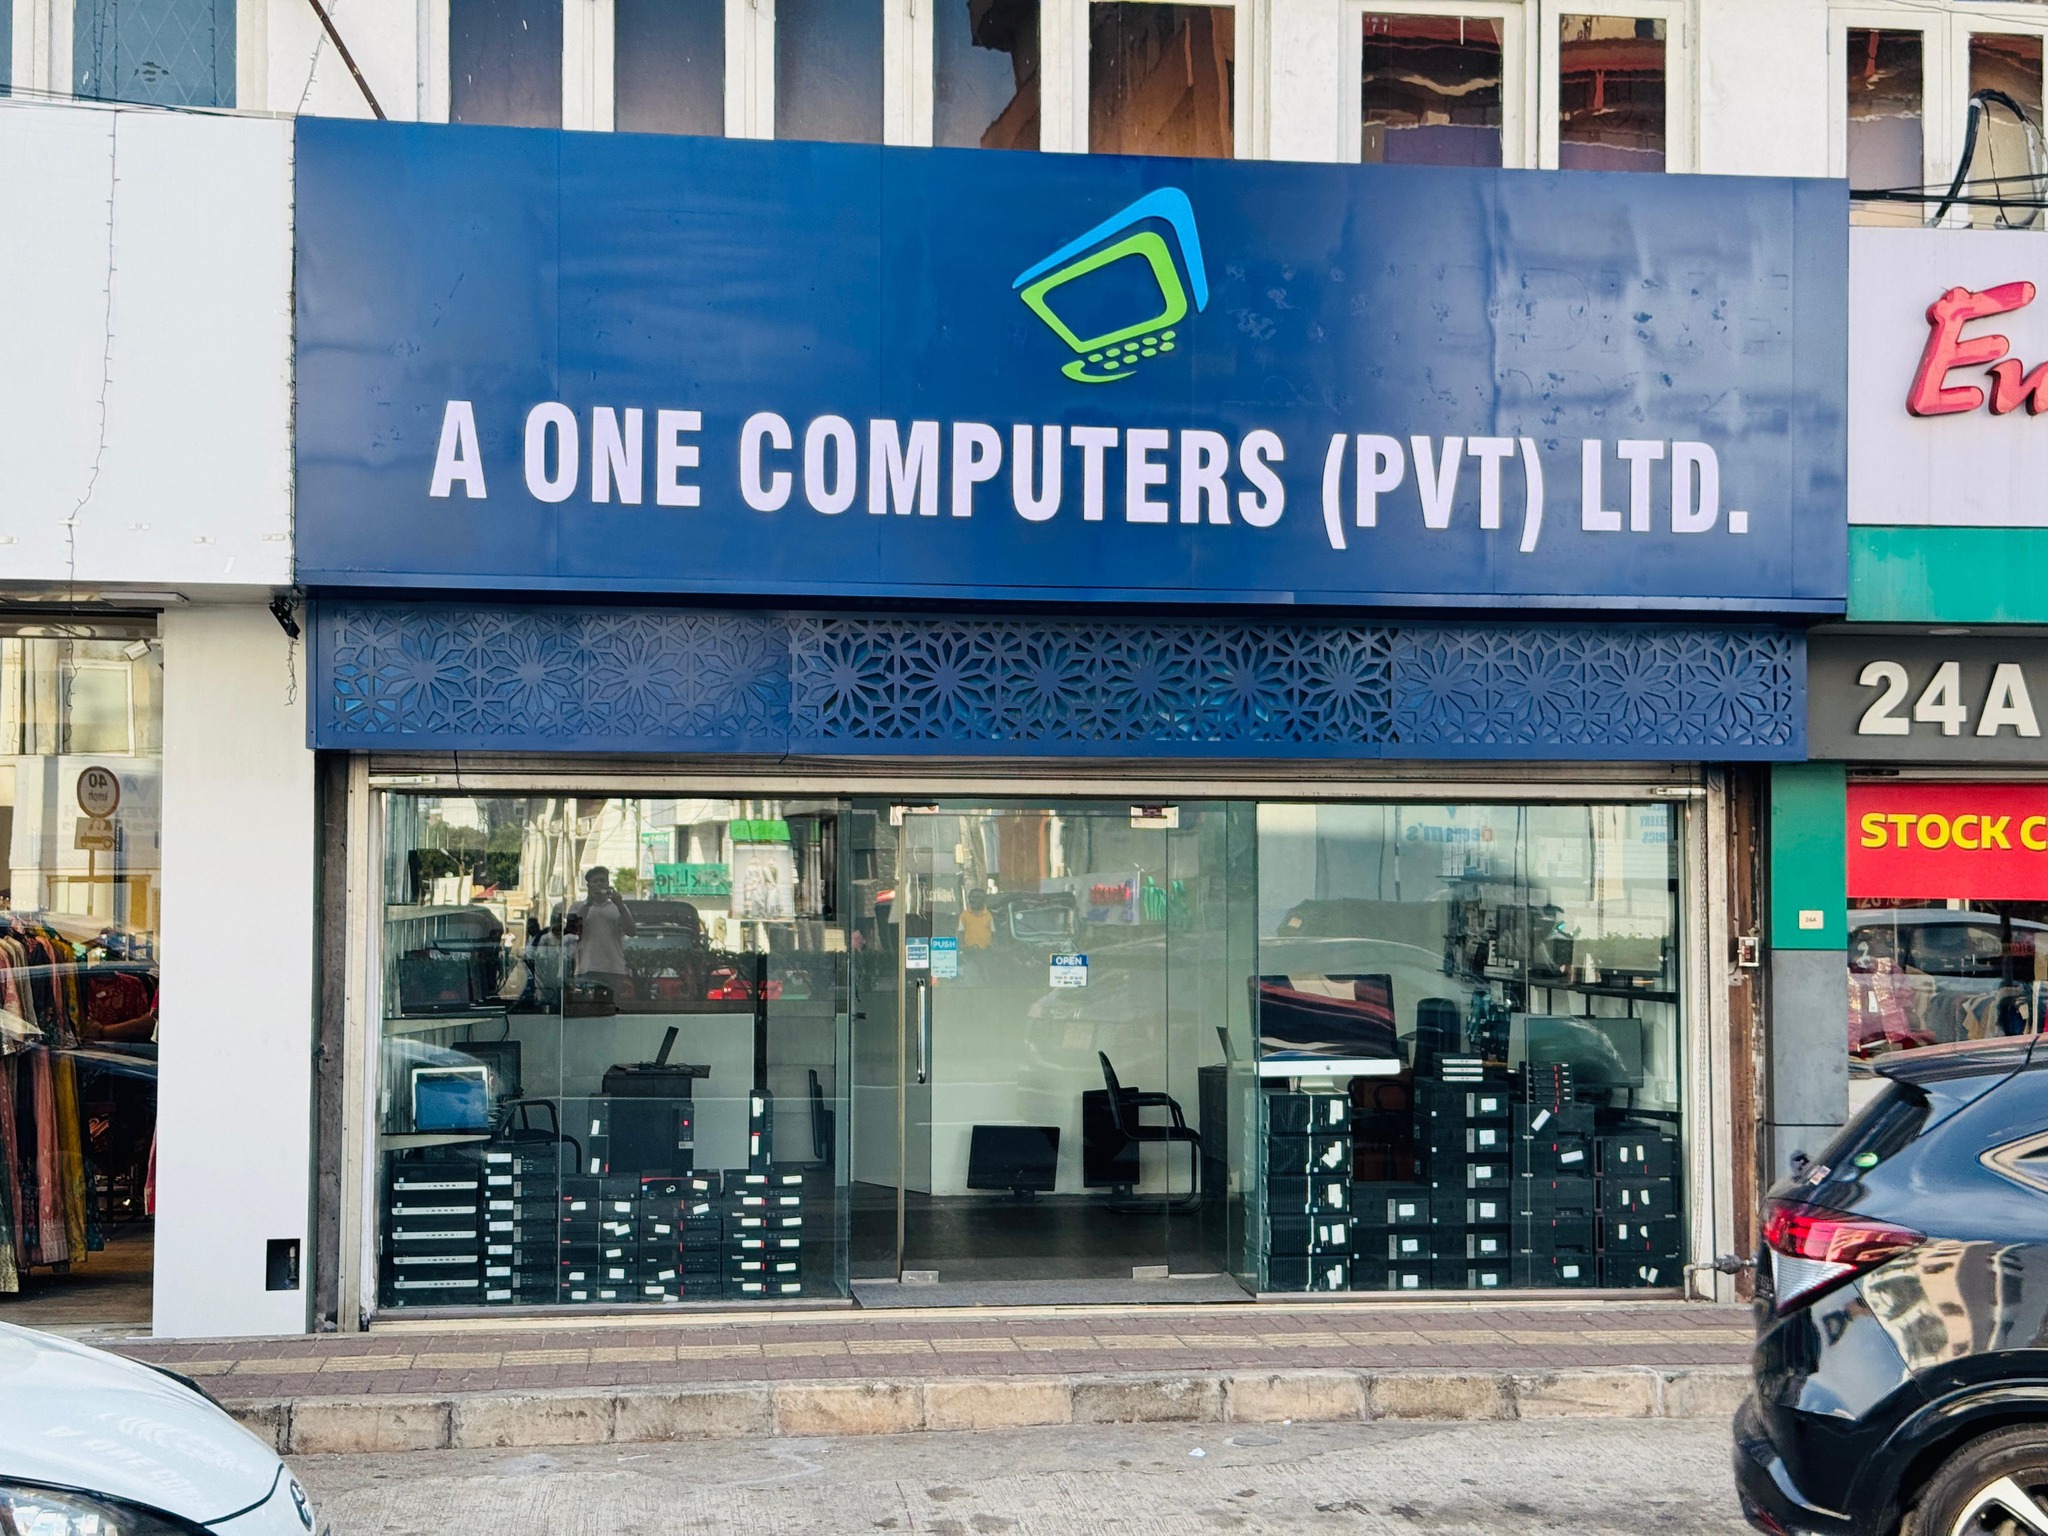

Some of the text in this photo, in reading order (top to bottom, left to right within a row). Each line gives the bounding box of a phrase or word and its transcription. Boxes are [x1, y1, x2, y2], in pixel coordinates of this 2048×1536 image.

[429, 400, 1749, 553] A ONE COMPUTERS (PVT) LTD.
[1860, 812, 2048, 852] STOCK C
[932, 940, 956, 948] PUSH
[1055, 956, 1082, 965] OPEN
